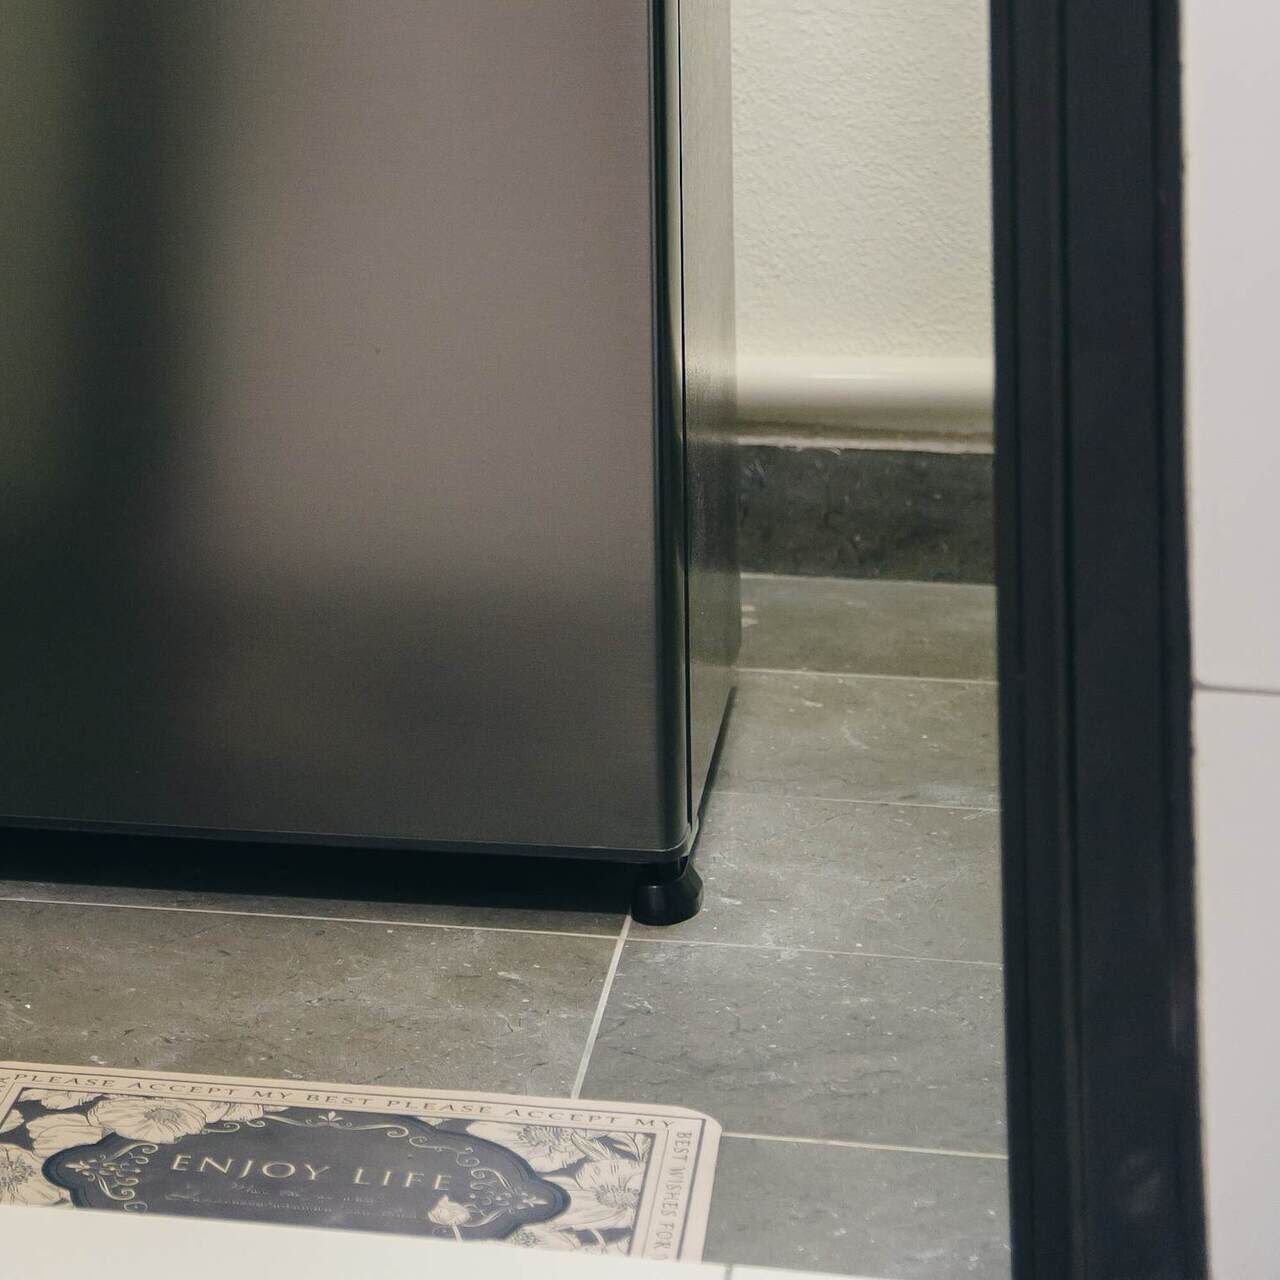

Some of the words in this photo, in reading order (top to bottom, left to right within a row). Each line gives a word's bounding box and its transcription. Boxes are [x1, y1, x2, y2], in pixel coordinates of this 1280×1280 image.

[15, 1073, 115, 1087] PLEASE
[127, 1081, 237, 1096] ACCEPT
[252, 1090, 293, 1100] MY
[306, 1094, 370, 1106] BEST
[387, 1099, 492, 1114] PLEASE
[505, 1108, 617, 1125] ACCEPT
[634, 1118, 675, 1128] MY
[672, 1132, 692, 1163] BEST
[171, 1154, 330, 1181] ENJOY
[353, 1168, 452, 1191] LIFE
[660, 1166, 686, 1217] WISHES
[653, 1222, 675, 1249] FOR
